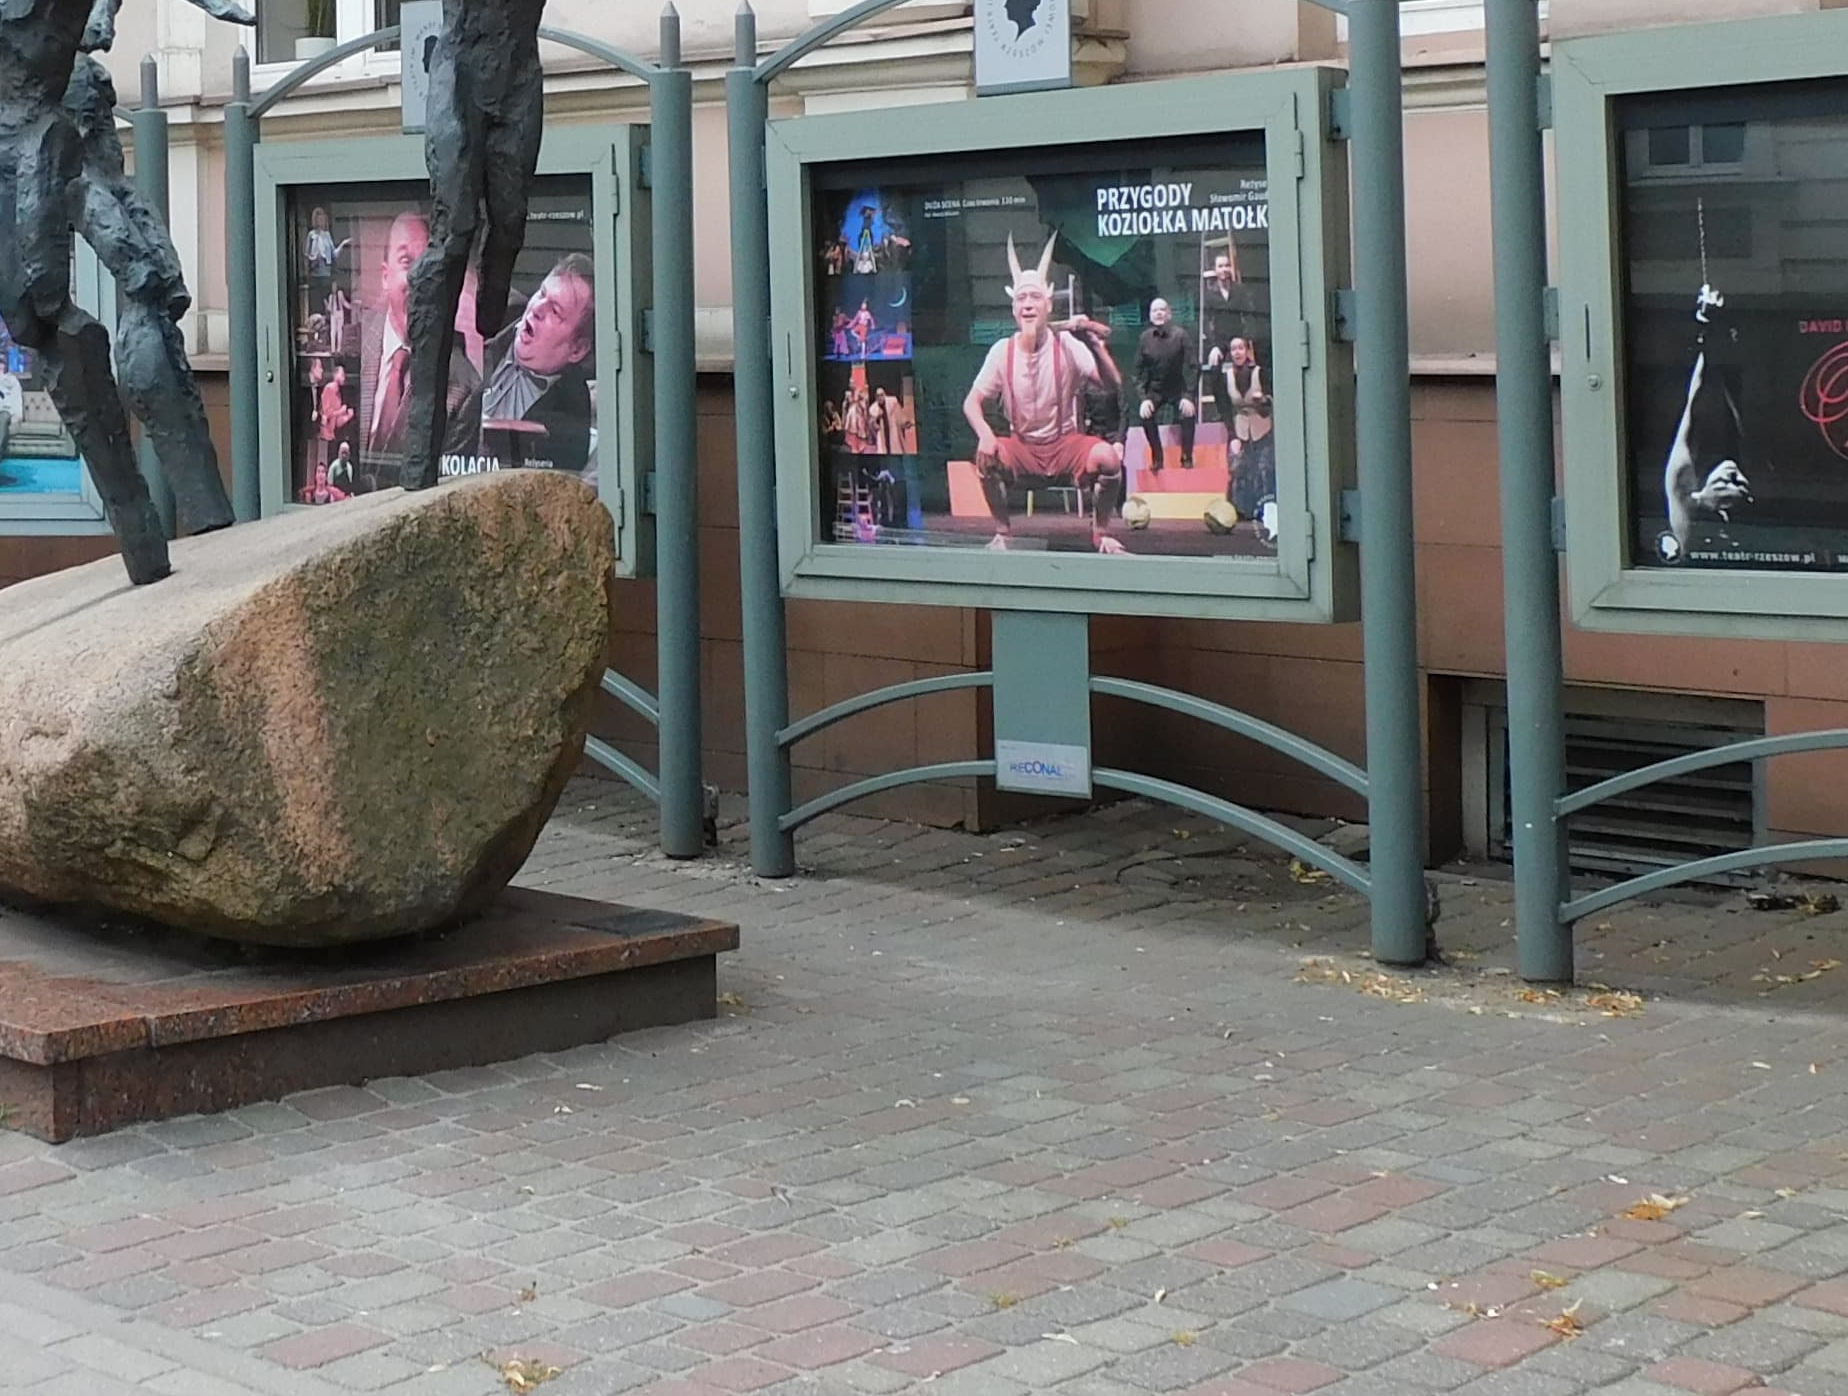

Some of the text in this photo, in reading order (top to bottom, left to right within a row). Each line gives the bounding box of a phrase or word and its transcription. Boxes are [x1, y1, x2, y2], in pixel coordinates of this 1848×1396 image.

[1097, 183, 1192, 211] PRZYGODY
[1098, 204, 1268, 236] KOZIOŁKA MATOŁK
[1799, 319, 1841, 333] DAVID
